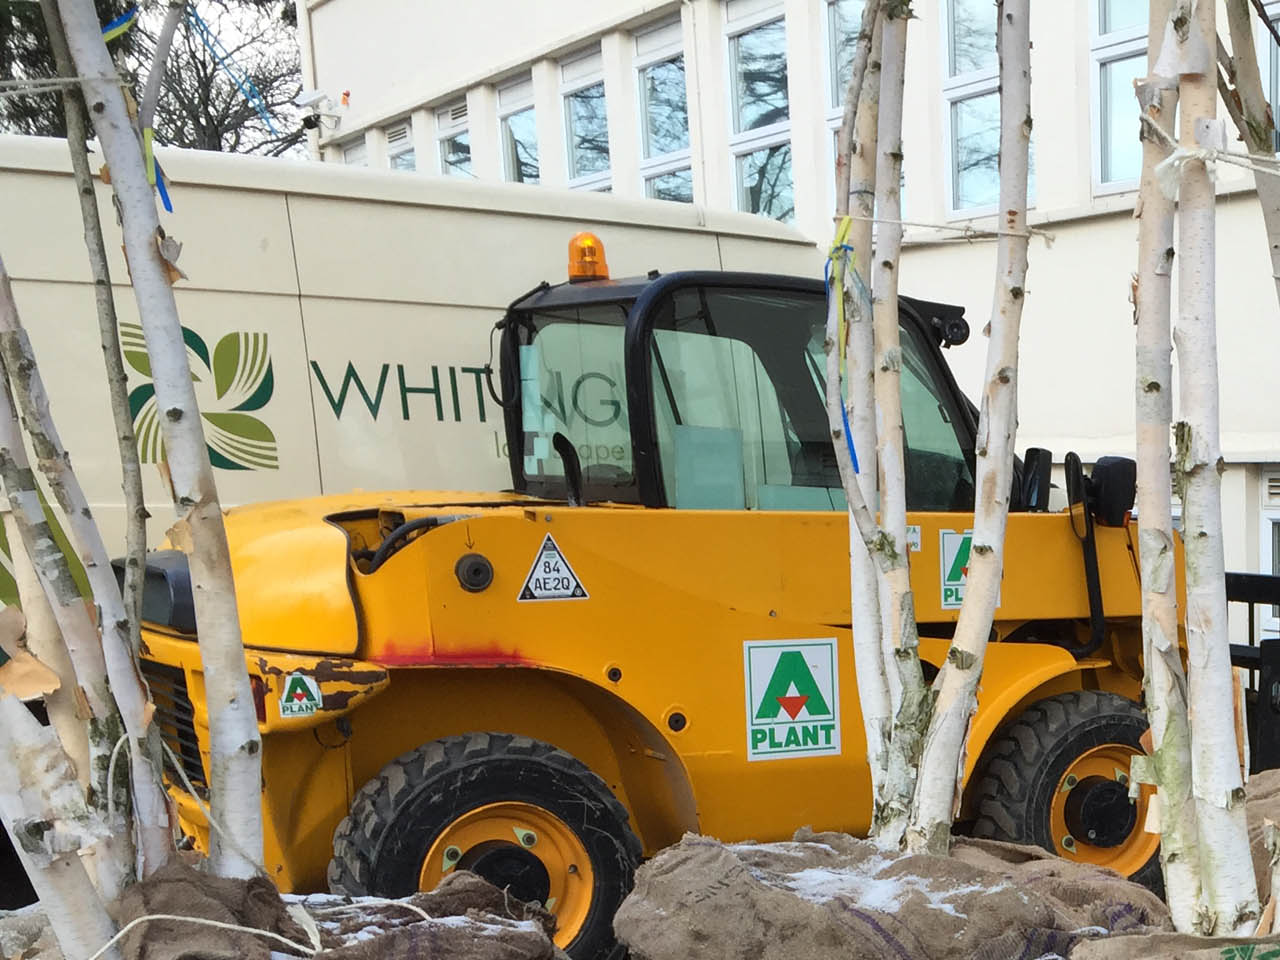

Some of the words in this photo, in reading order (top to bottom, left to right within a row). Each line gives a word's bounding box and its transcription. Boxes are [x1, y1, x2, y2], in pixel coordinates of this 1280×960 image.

[310, 360, 622, 427] WHITNG
[543, 560, 561, 575] 84
[534, 576, 571, 592] AE2Q
[751, 723, 836, 751] PLANT
